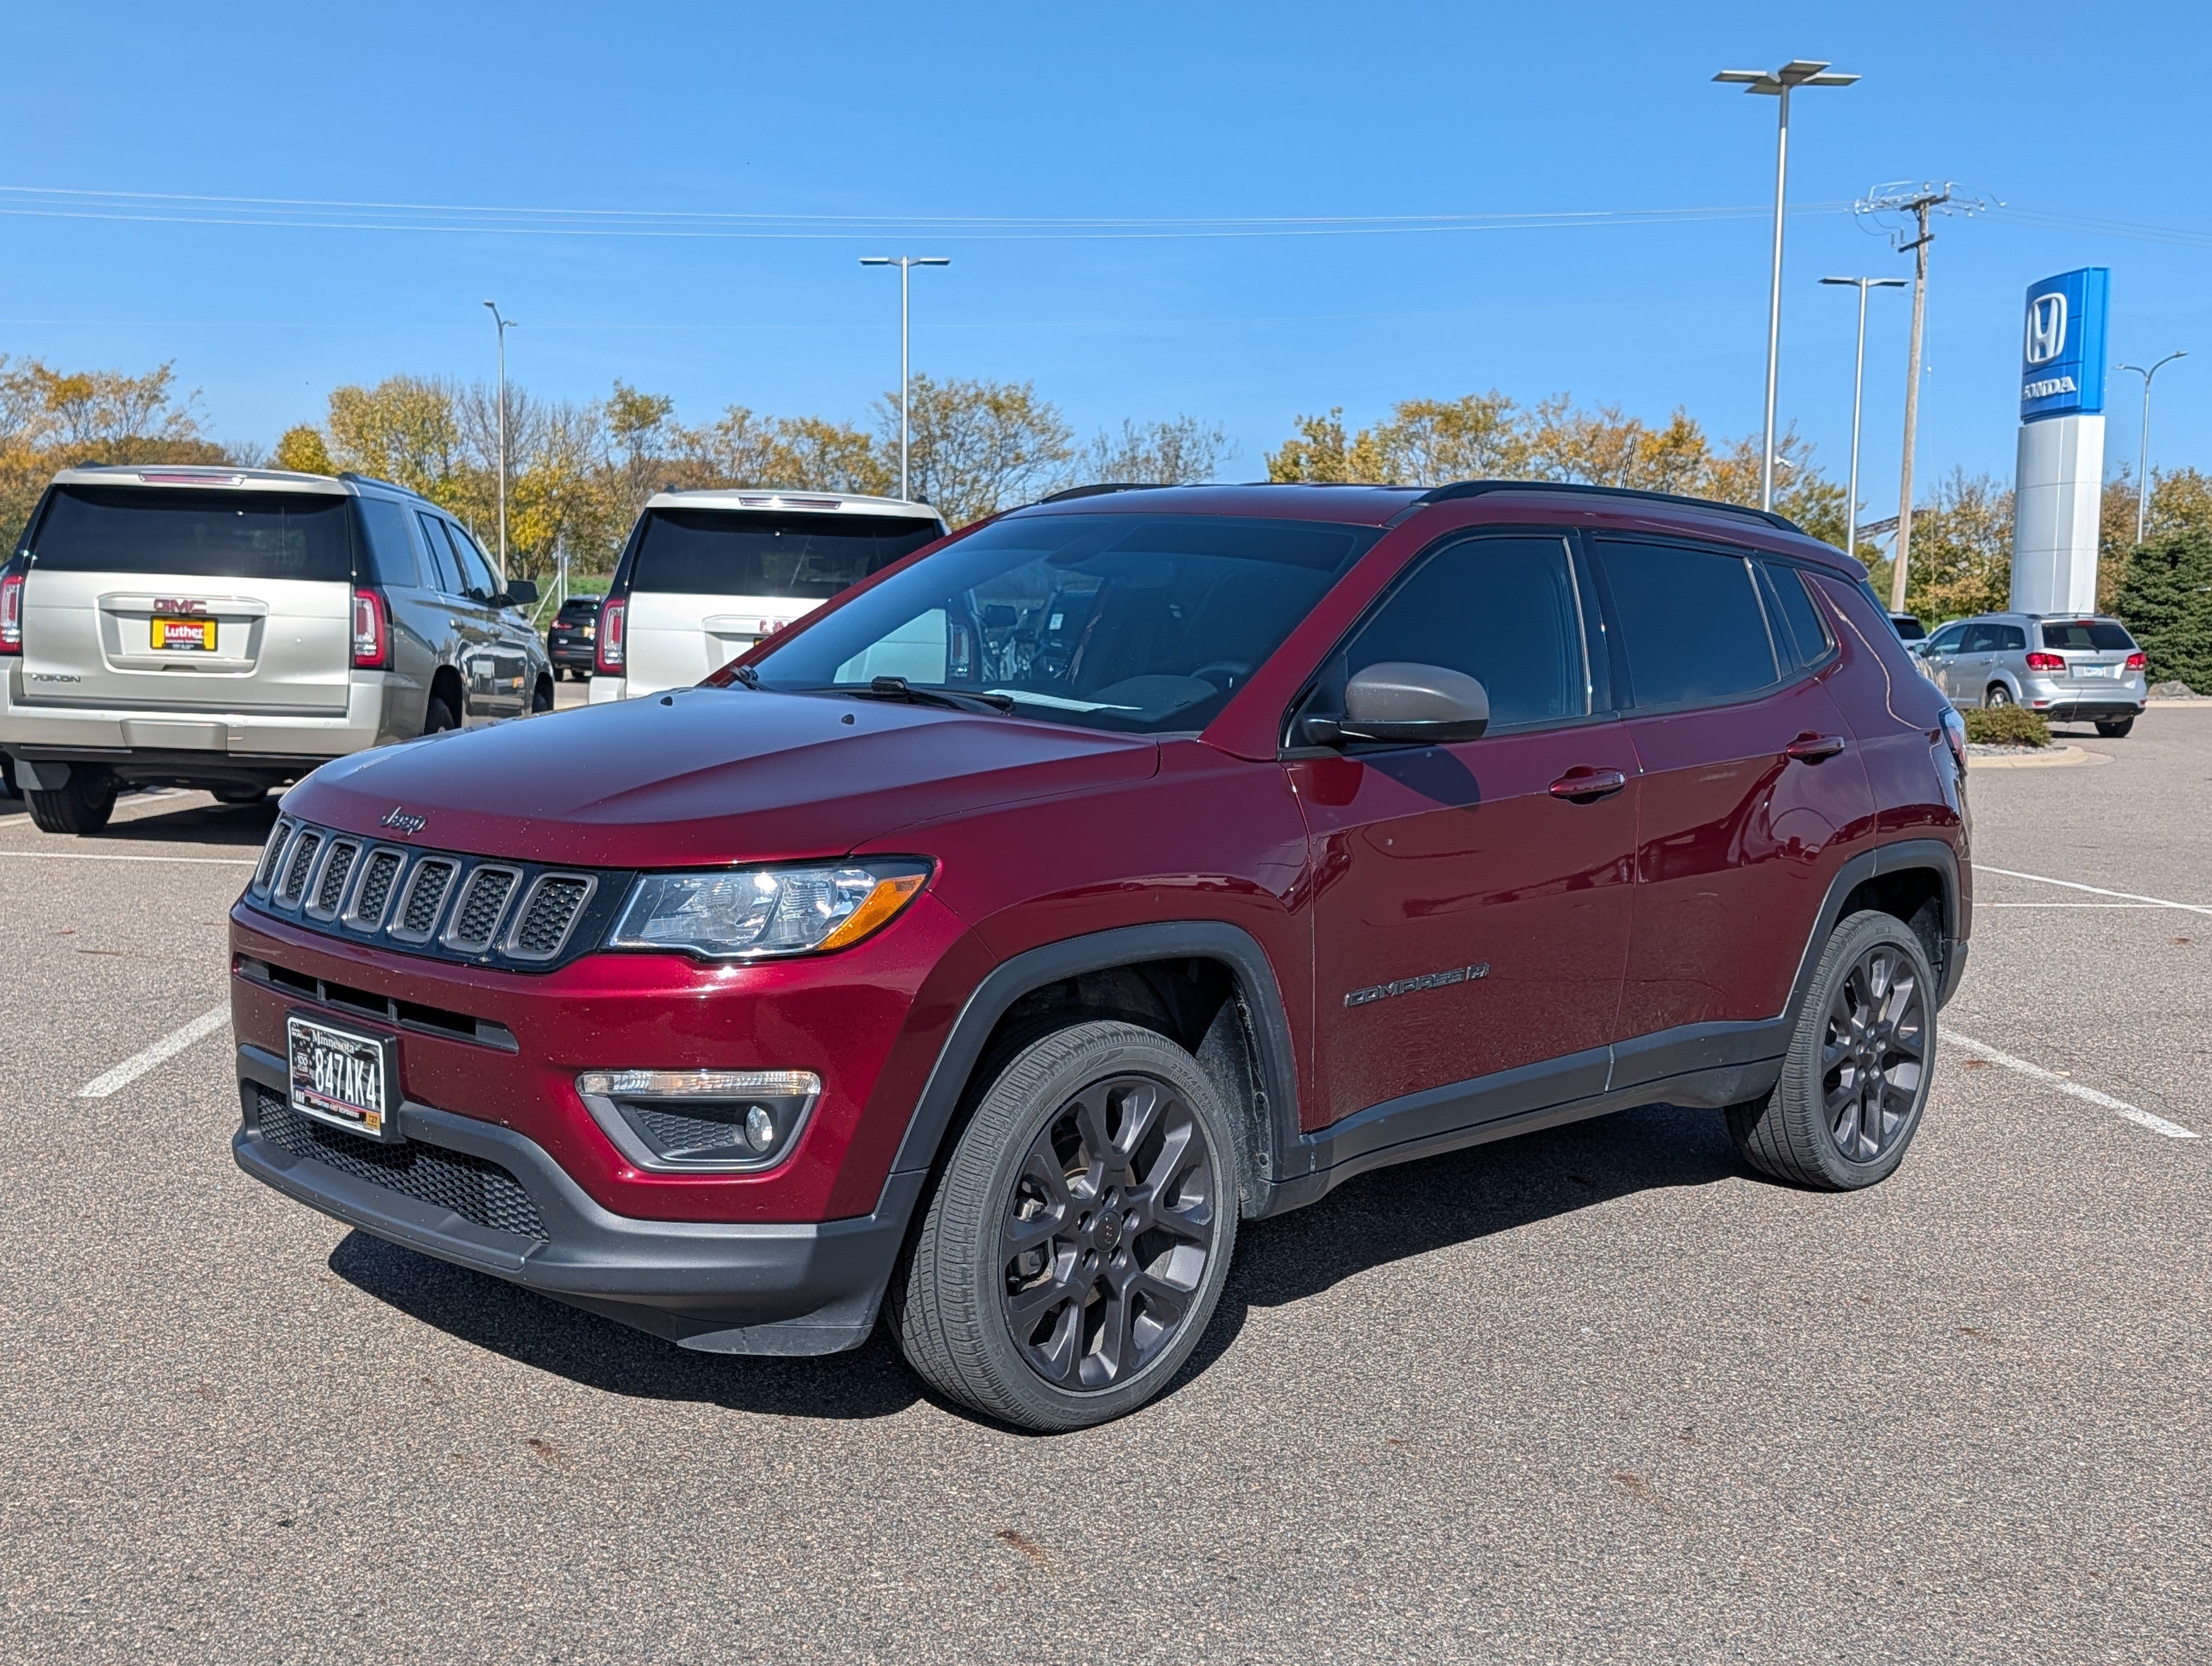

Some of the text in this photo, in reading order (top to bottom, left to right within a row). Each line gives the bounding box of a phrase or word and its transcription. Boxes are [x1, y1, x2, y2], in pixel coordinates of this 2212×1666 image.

[153, 599, 207, 613] GMC
[165, 625, 204, 638] Luther
[381, 806, 427, 836] Jeep
[1345, 969, 1464, 1007] COMPASS
[310, 1028, 355, 1054] Minnesota
[315, 1048, 376, 1109] 847AK4
